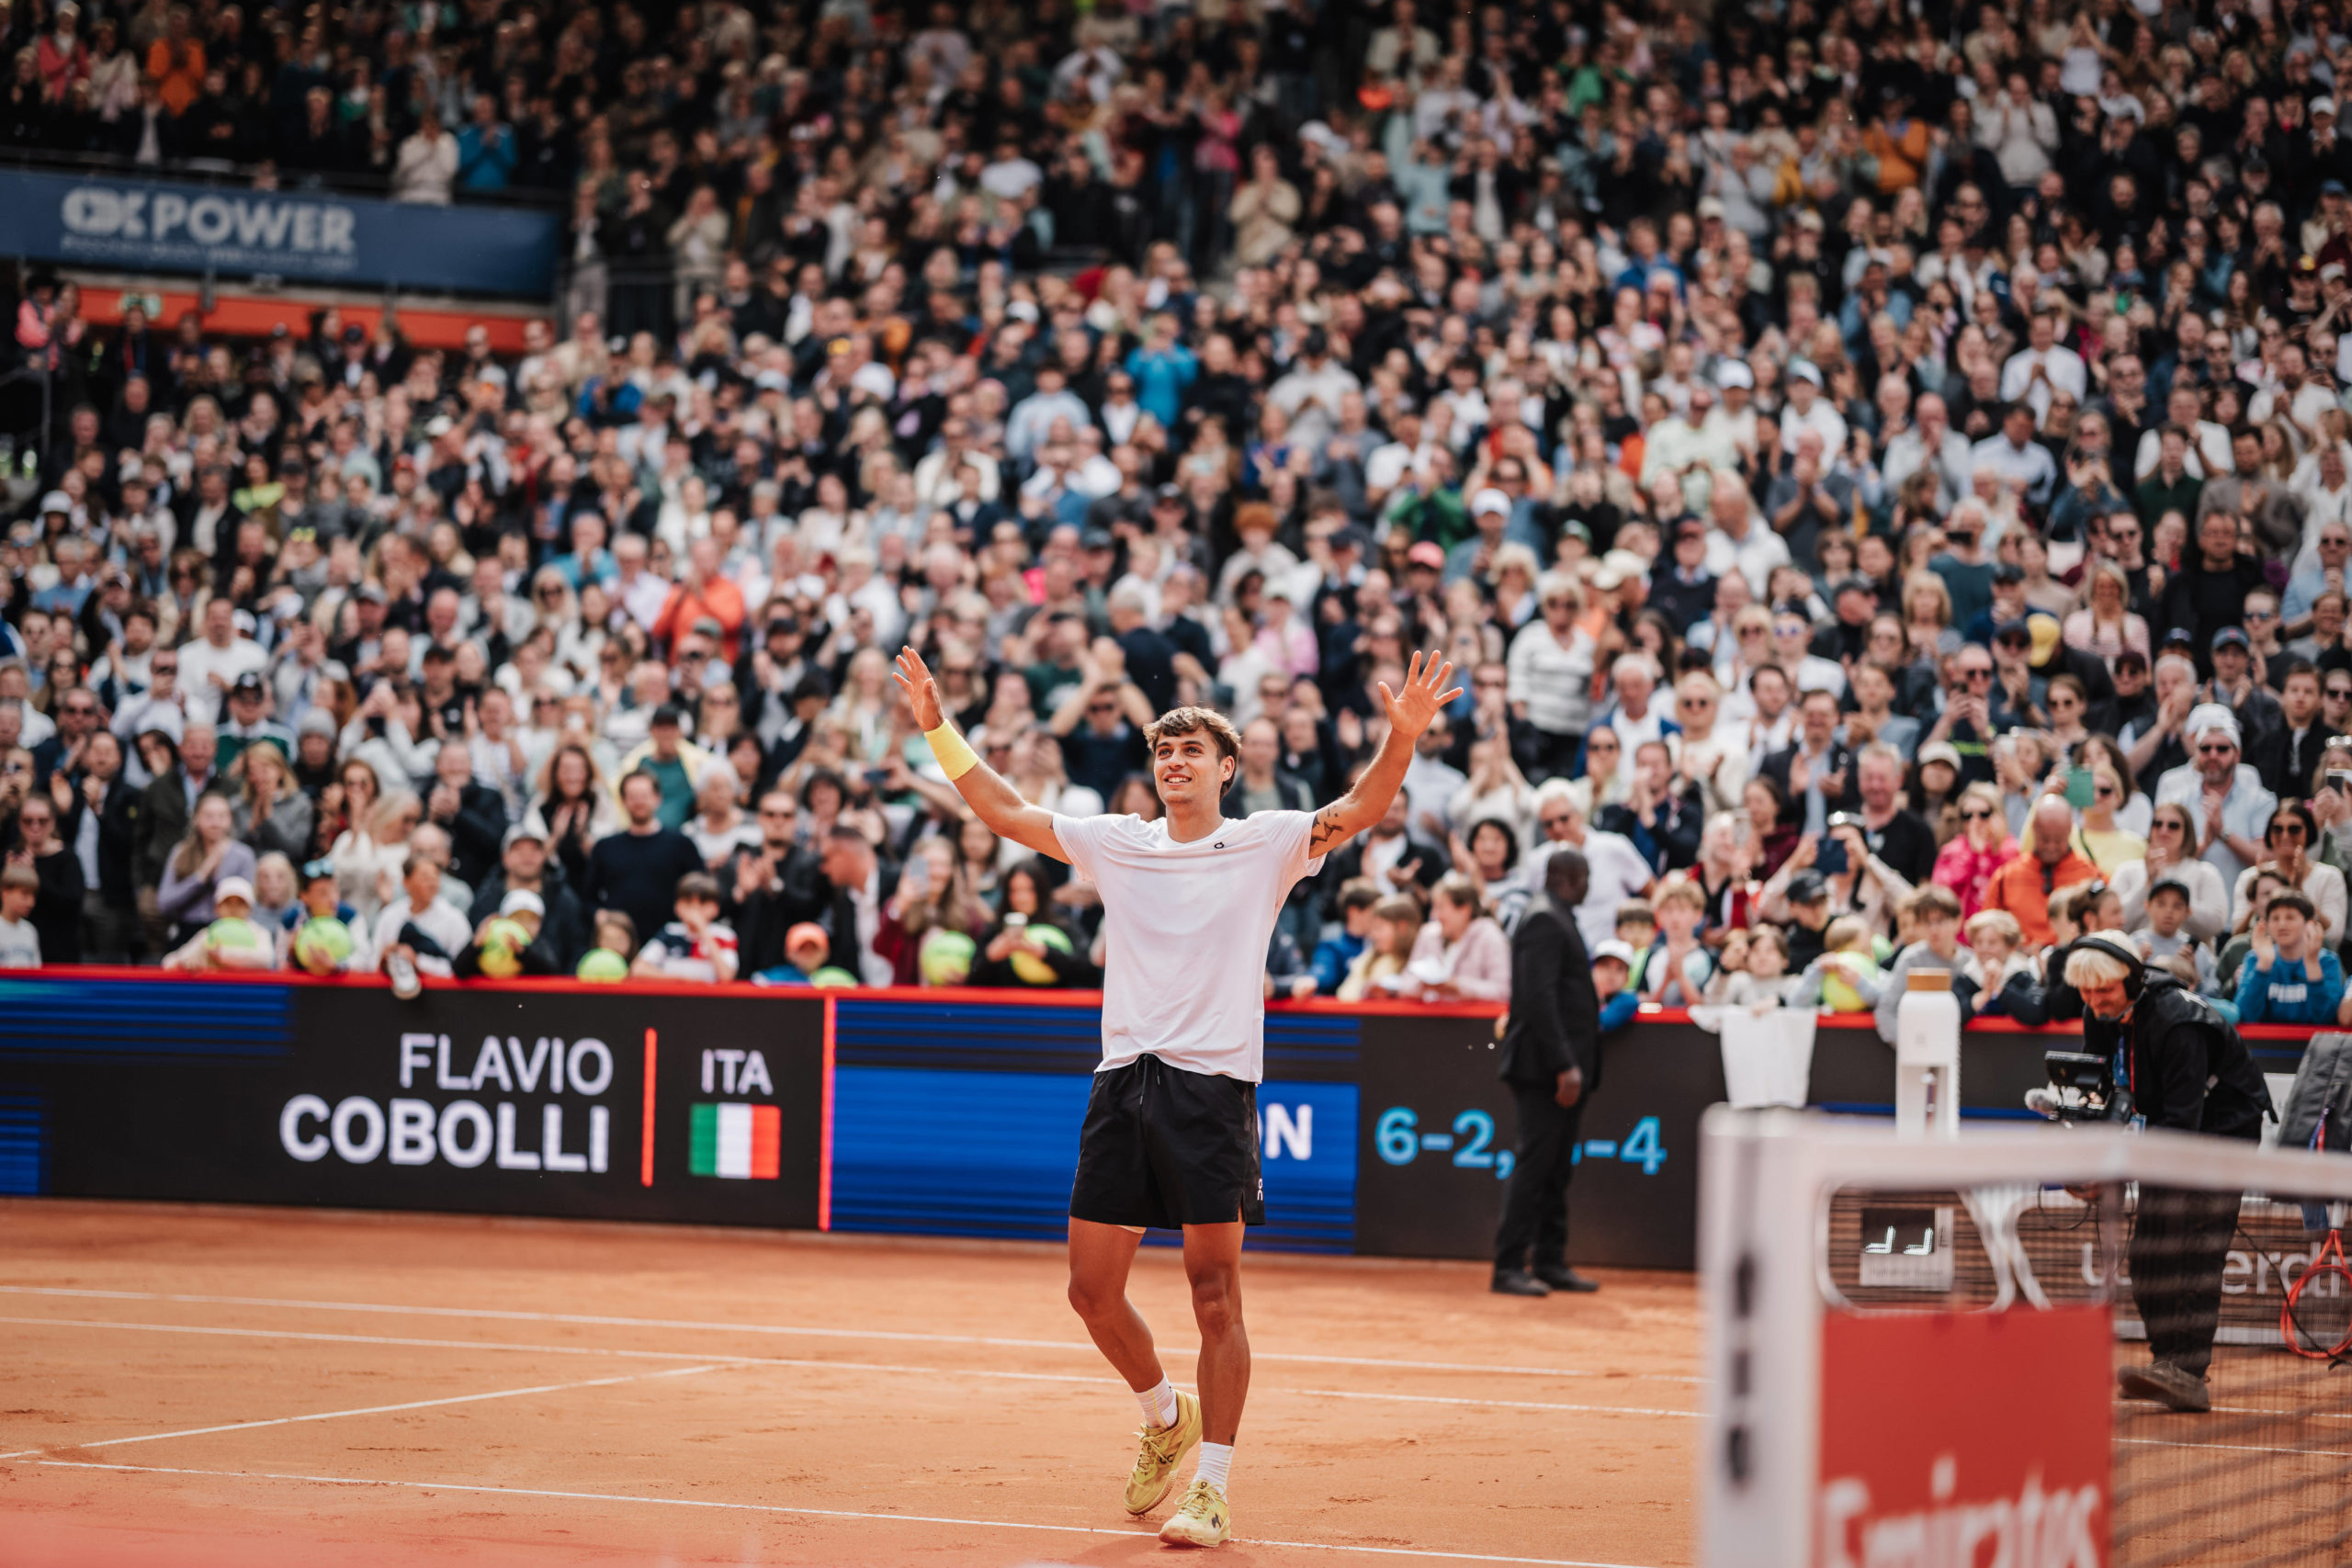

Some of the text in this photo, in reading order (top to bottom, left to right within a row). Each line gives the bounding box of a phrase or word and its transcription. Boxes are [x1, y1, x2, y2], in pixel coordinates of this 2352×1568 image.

[152, 192, 356, 254] POWER
[400, 1032, 615, 1097] FLAVIO
[701, 1048, 775, 1097] ITA
[278, 1094, 610, 1173] COBOLLI
[1375, 1106, 1668, 1180] 6-2, -4
